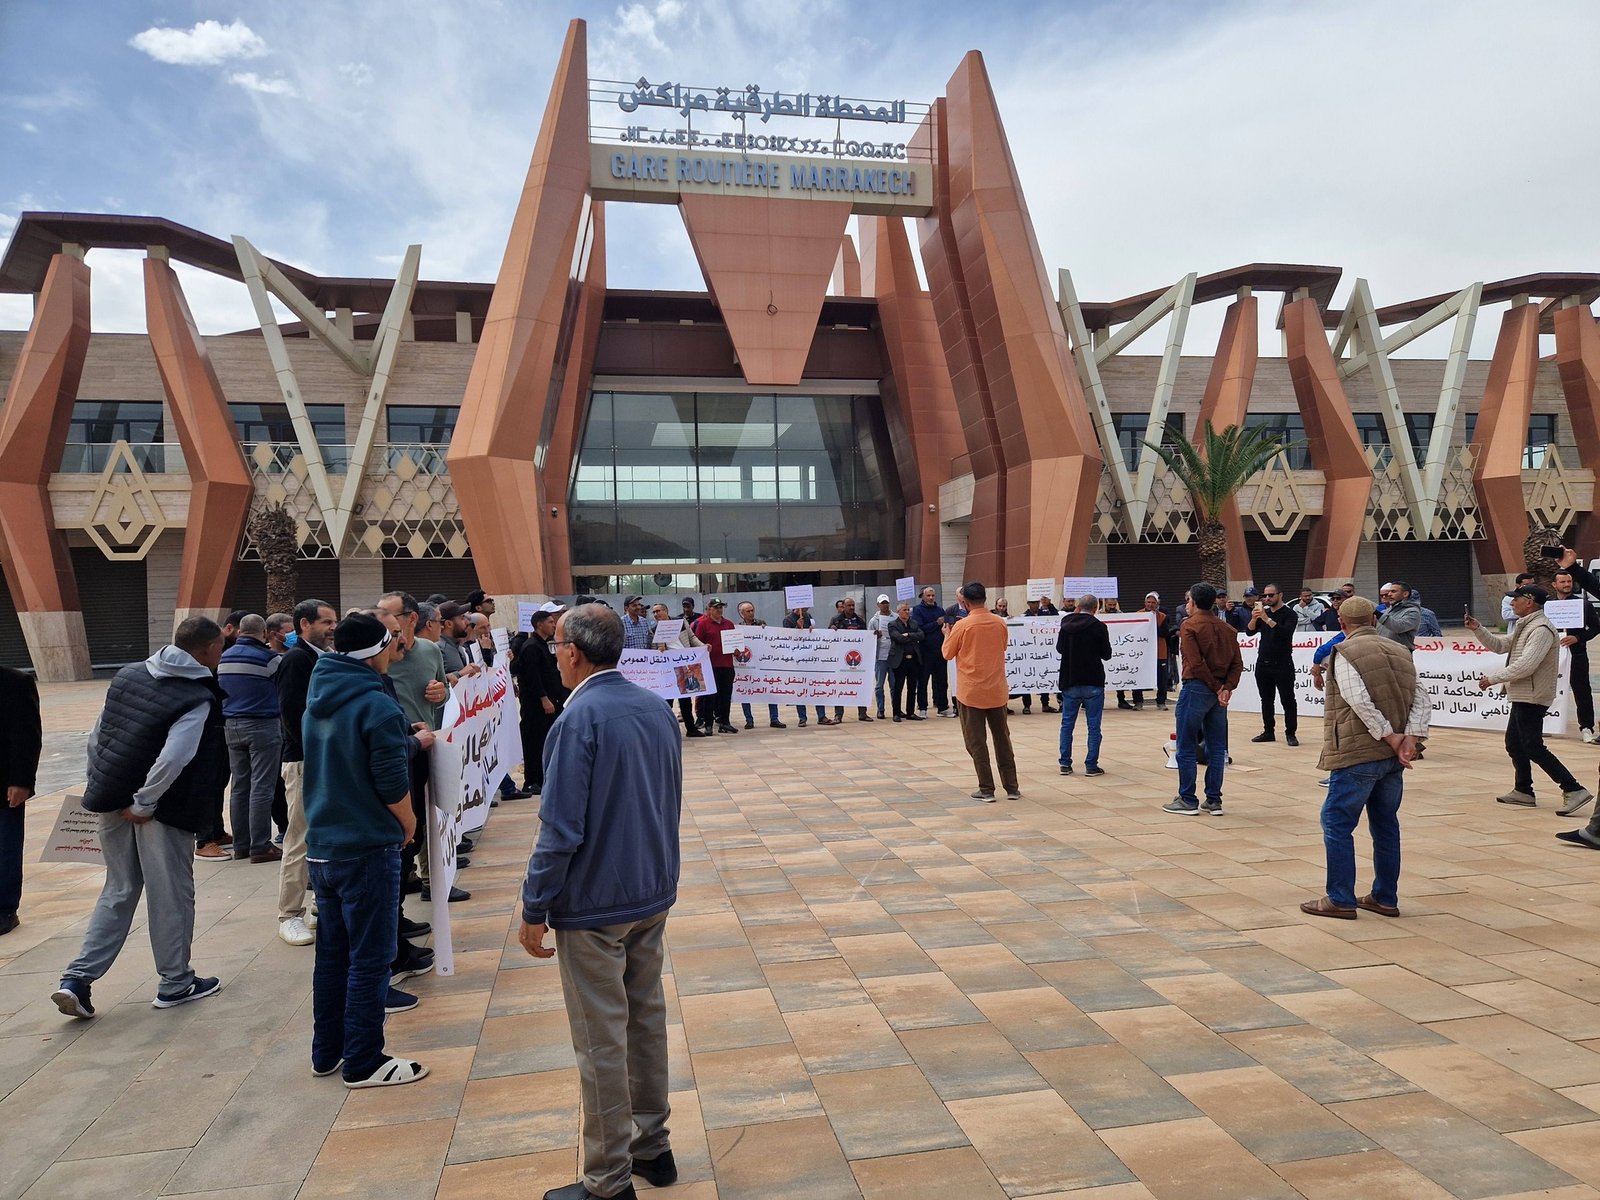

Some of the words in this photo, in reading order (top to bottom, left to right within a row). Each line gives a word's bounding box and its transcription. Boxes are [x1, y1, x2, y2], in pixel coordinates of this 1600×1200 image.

[618, 76, 708, 118] مراكش
[714, 84, 810, 124] الطرقية
[815, 94, 905, 124] المحطة
[611, 152, 669, 181] GARE
[677, 154, 780, 188] ROUTIÈRE
[789, 164, 916, 196] MARRAKECH
[1020, 636, 1037, 647] أحد
[1113, 634, 1134, 646] تكرار
[1136, 636, 1149, 644] بعد
[1292, 637, 1322, 648] الفس
[1414, 641, 1444, 652] المح
[1005, 652, 1027, 663] الطرقي
[1128, 650, 1144, 659] دون
[620, 656, 648, 665] العمومي
[649, 656, 670, 665] النقل
[1006, 667, 1020, 678] العز
[1024, 667, 1036, 677] إلى
[1419, 671, 1453, 682] ومستع
[733, 674, 760, 683] مراكش
[784, 677, 807, 685] النقل
[1295, 680, 1312, 689] الدو
[769, 686, 795, 695] محطة
[797, 688, 808, 698] إلى
[810, 689, 836, 698] الرحيل
[838, 690, 857, 698] بعدم
[1444, 686, 1484, 697] محاكمة
[1431, 701, 1444, 710] الع
[1449, 702, 1477, 713] المال
